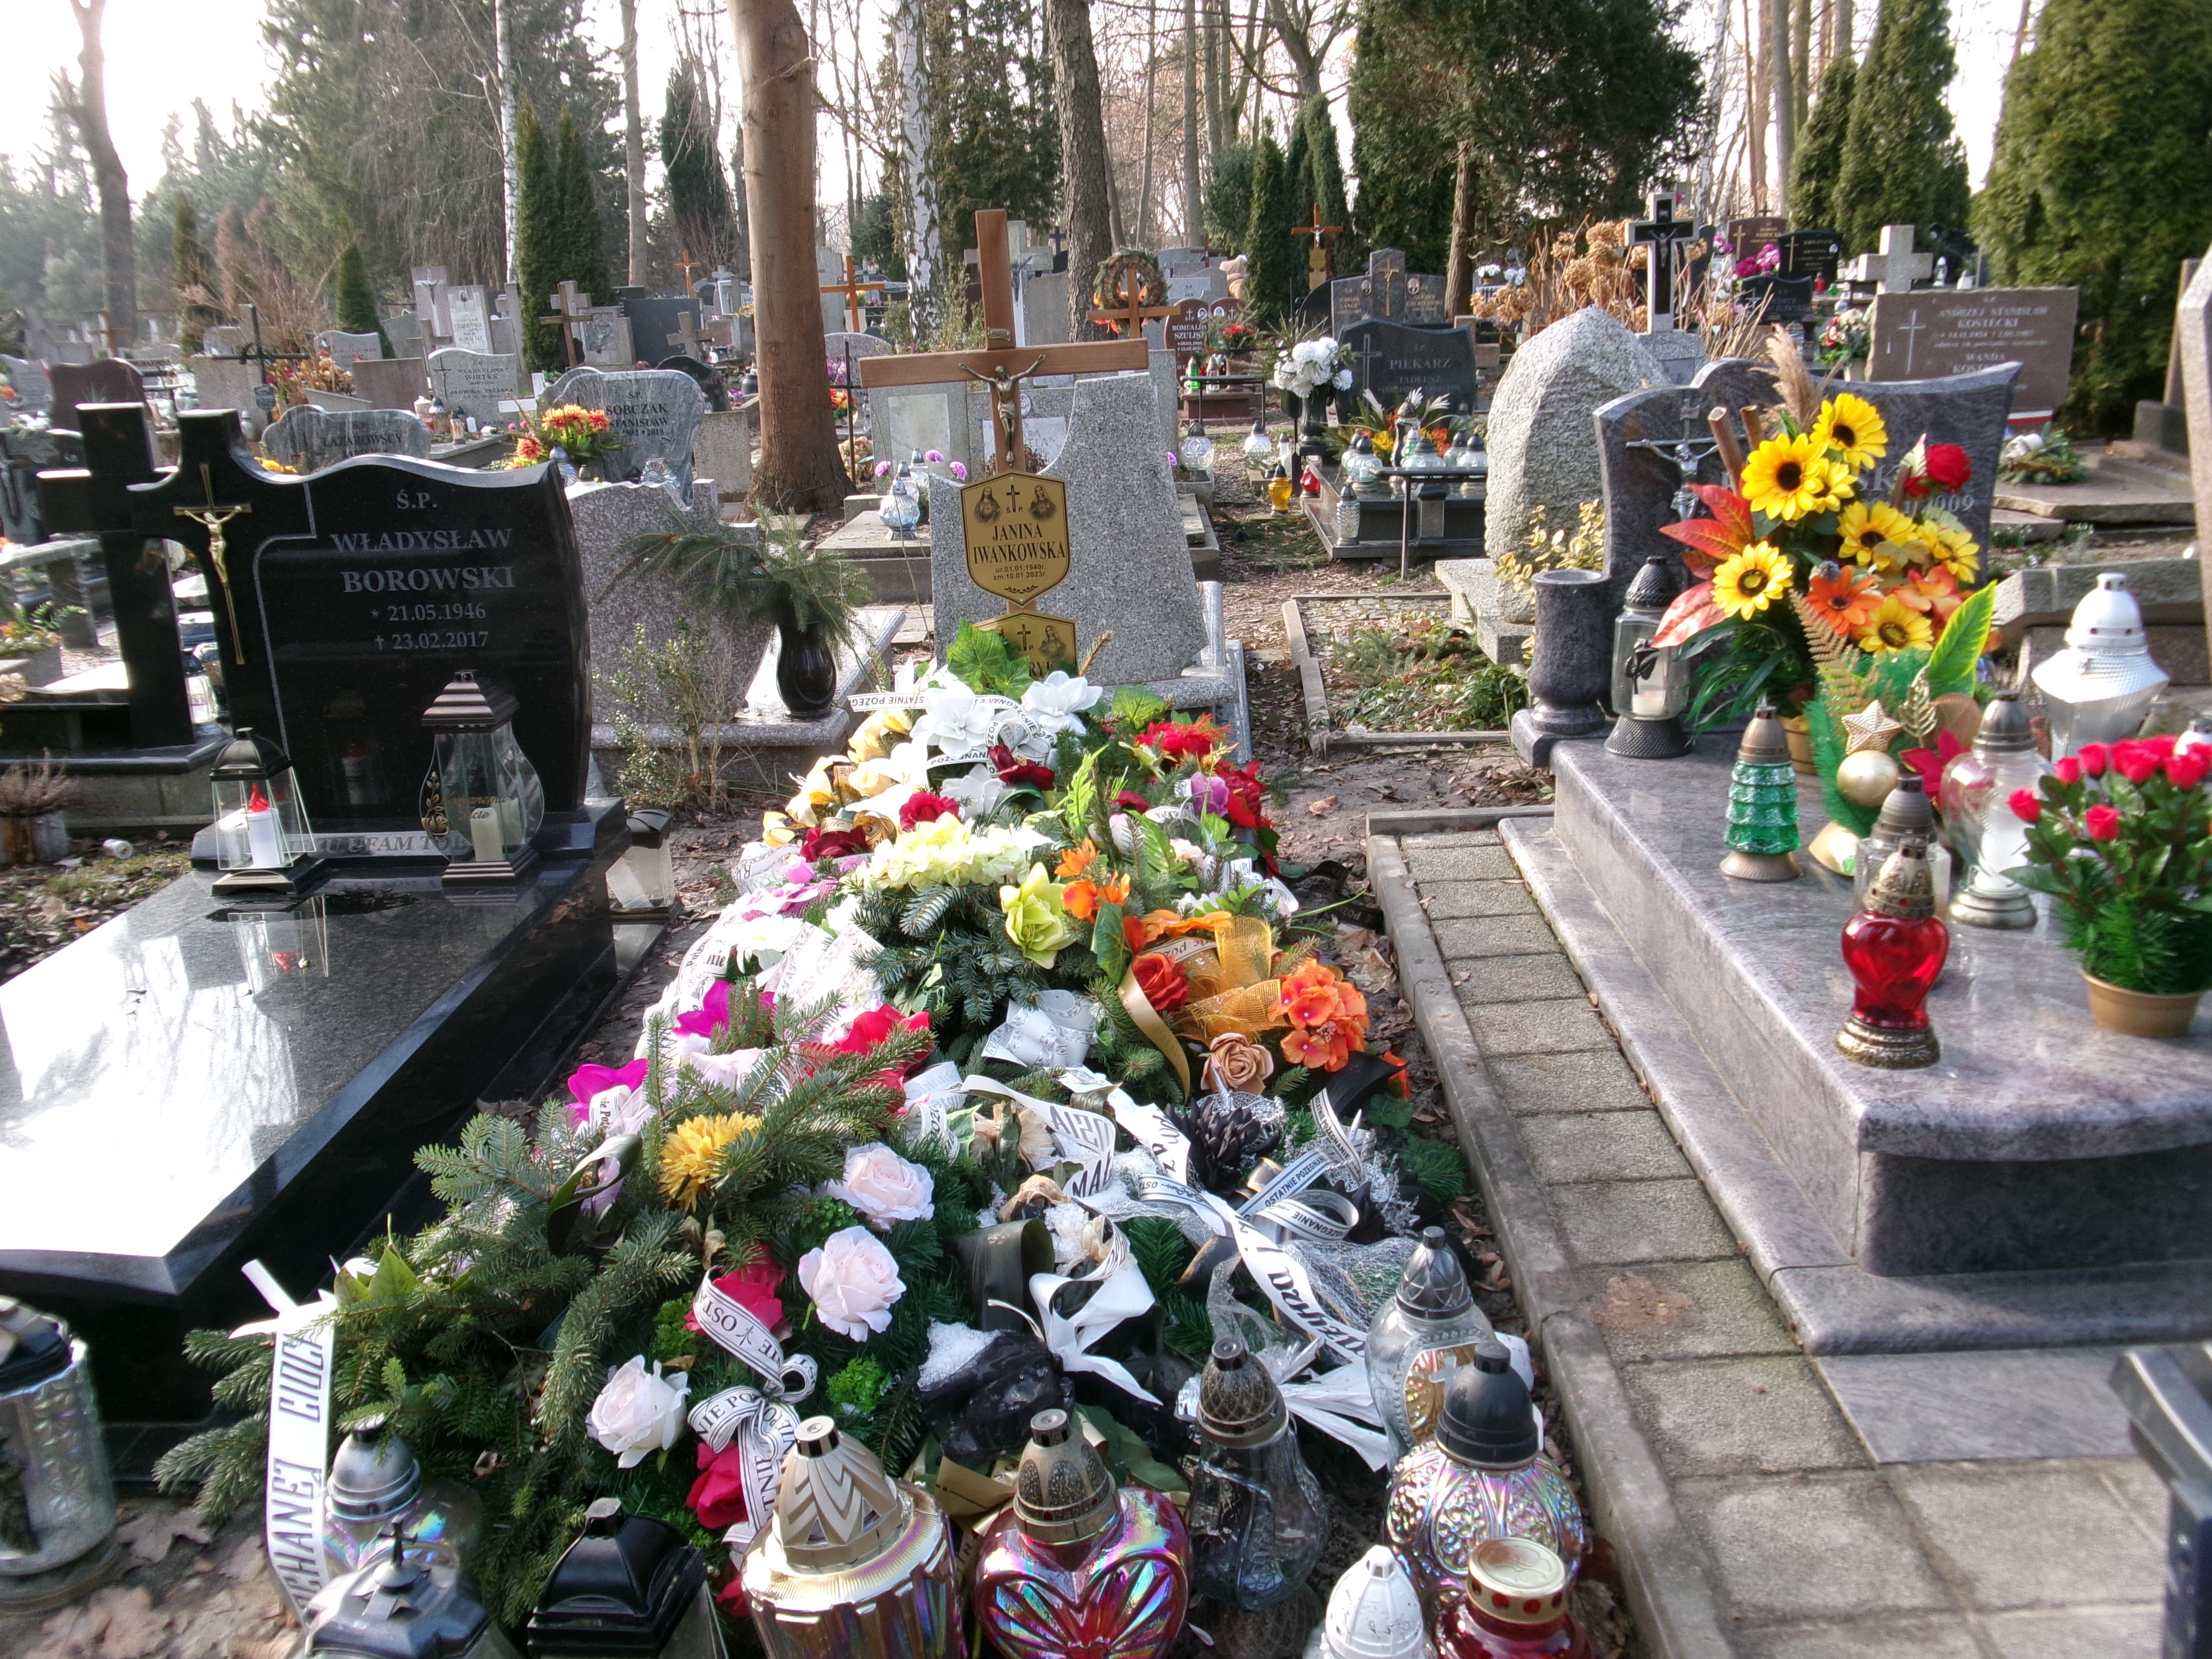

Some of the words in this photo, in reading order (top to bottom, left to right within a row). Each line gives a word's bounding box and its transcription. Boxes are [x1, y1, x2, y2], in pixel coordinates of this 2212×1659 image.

[1390, 358, 1451, 370] PIEKARZ
[606, 403, 668, 415] SOBCZAK
[397, 489, 437, 509] Ś.P.
[330, 529, 512, 553] WŁADYSŁAW
[993, 523, 1043, 541] JANINA
[973, 541, 1066, 565] IWANKOWSKA
[340, 566, 516, 592] BOROWSKI
[1264, 1177, 1298, 1208] OSTATNIE
